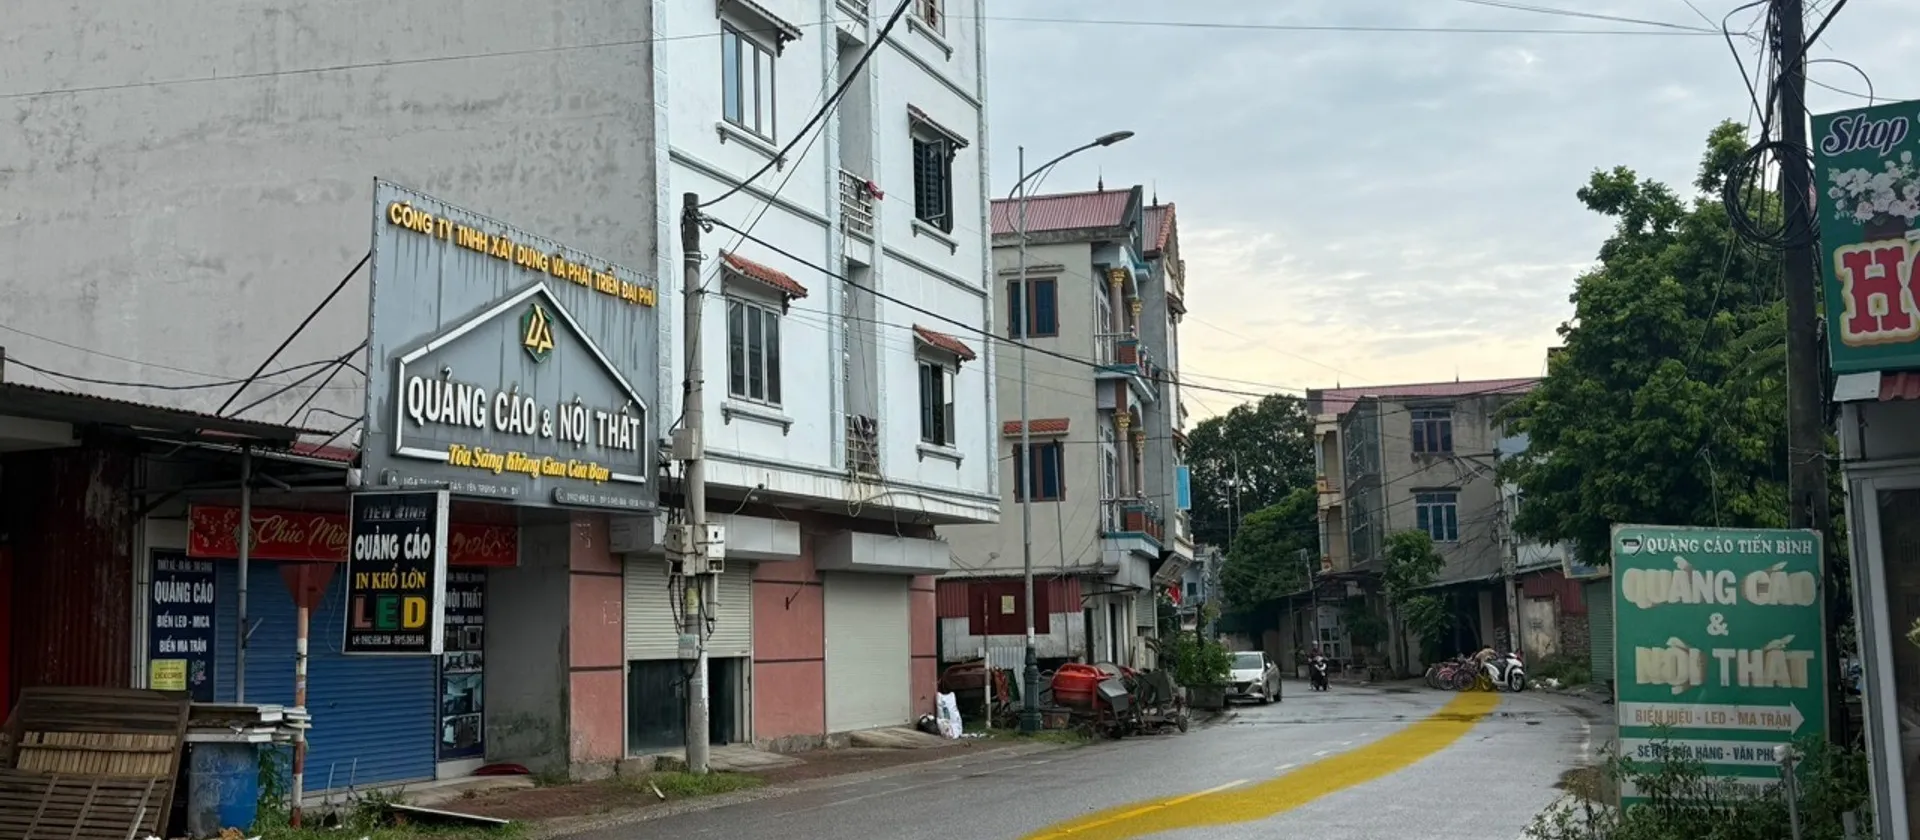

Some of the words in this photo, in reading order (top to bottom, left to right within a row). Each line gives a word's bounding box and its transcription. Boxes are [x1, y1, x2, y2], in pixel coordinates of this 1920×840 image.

[1821, 113, 1908, 157] Shop
[388, 200, 433, 234] CÔNG
[436, 217, 453, 240] TY
[457, 225, 488, 252] TNHH
[491, 234, 514, 260] XÂY
[516, 246, 548, 272] DỰNG
[551, 253, 566, 279] VÀ
[1836, 239, 1920, 344] H
[407, 366, 487, 428] QUẢNG
[494, 385, 536, 435] CÁO
[542, 408, 553, 438] &
[560, 396, 590, 449] NỘI
[597, 400, 640, 450] THẤT
[472, 446, 503, 474] Sáng
[506, 451, 540, 479] Không
[542, 456, 566, 477] Gian
[588, 461, 609, 485] Bạn
[251, 514, 304, 543] Chúc
[355, 525, 399, 561] QUẢNG
[404, 526, 431, 560] CÁO
[1647, 535, 1699, 555] QUẢNG
[1703, 535, 1734, 553] CÁO
[1738, 533, 1772, 554] TIẾN
[1776, 536, 1812, 555] BÌNH
[154, 574, 190, 604] QUẢNG
[193, 577, 214, 604] CÁO
[355, 572, 368, 589] IN
[372, 563, 398, 589] KHỔ
[1622, 555, 1737, 609] QUẢNG
[1742, 561, 1817, 606] CÁO
[353, 595, 427, 630] LED
[461, 587, 482, 609] THẤT
[174, 615, 187, 628] LED
[193, 615, 210, 628] MICA
[1706, 613, 1729, 636] &
[1635, 636, 1704, 695] NỘI
[1712, 634, 1815, 688] THẤT
[1705, 712, 1725, 724] LED
[1738, 711, 1757, 725] MA
[1760, 711, 1792, 729] TRẬN
[1695, 744, 1723, 760] HÀNG
[1733, 745, 1753, 761] VĂN
